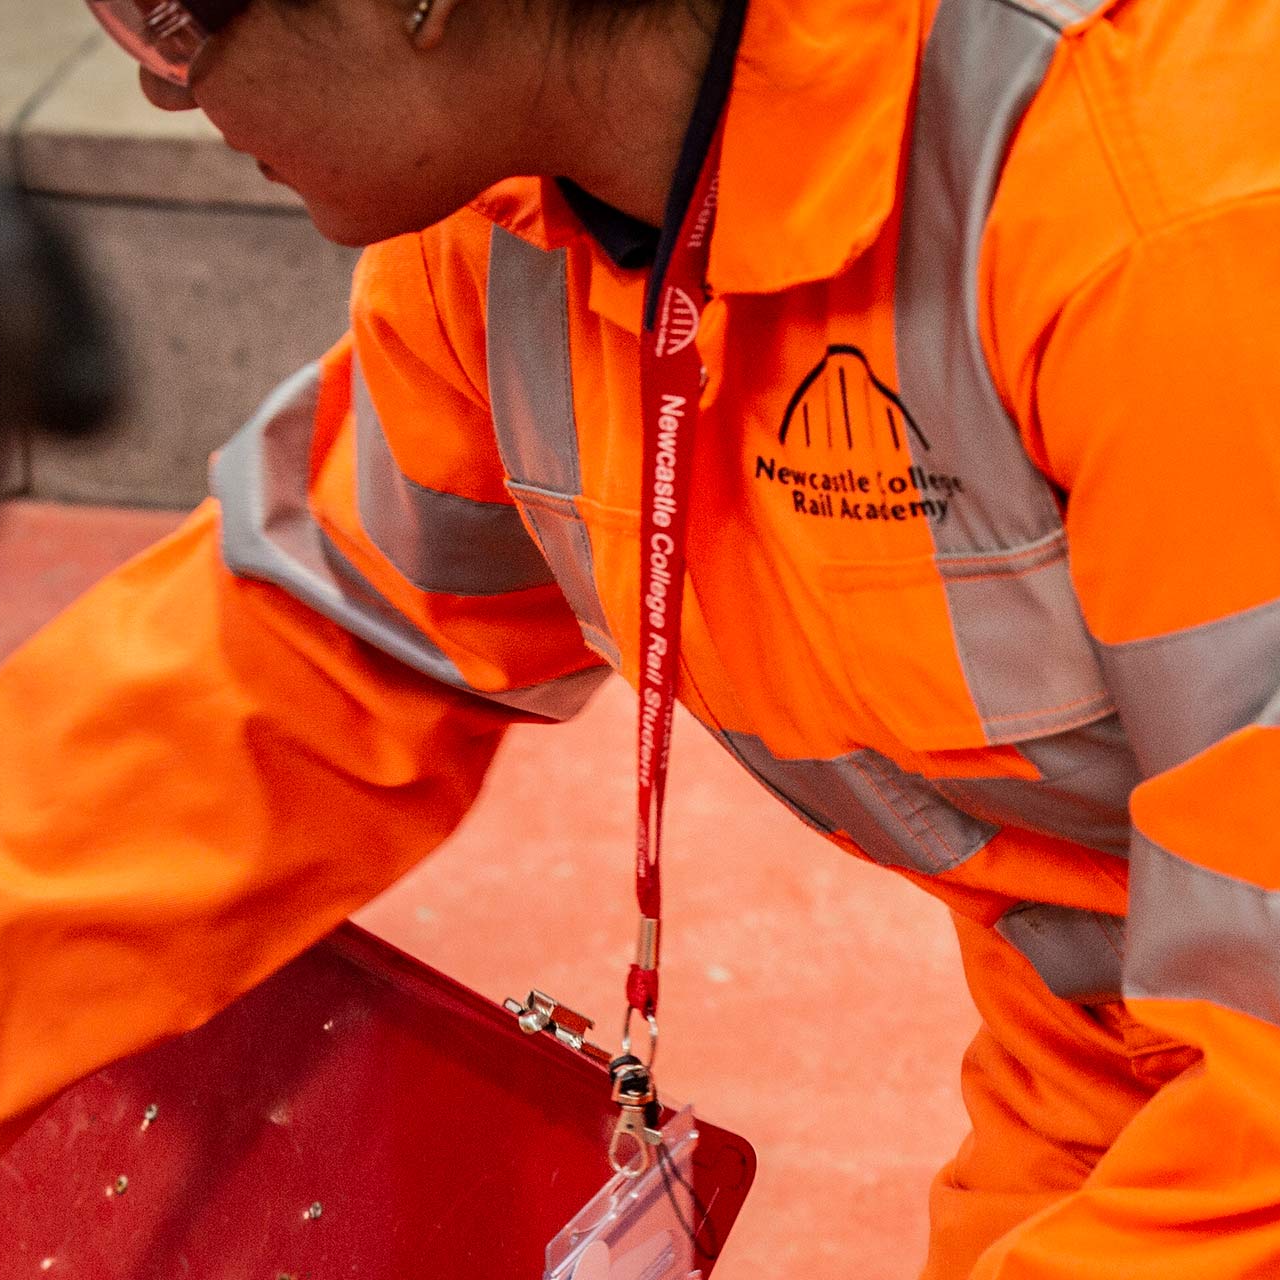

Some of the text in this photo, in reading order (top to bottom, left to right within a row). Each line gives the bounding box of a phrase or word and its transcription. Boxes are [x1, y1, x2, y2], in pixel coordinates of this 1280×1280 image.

[652, 394, 687, 528] Newcastle
[755, 455, 870, 493] Newcastle
[792, 489, 834, 518] Rail
[645, 532, 675, 629] College
[645, 632, 668, 686] Rail
[639, 687, 662, 788] Student
